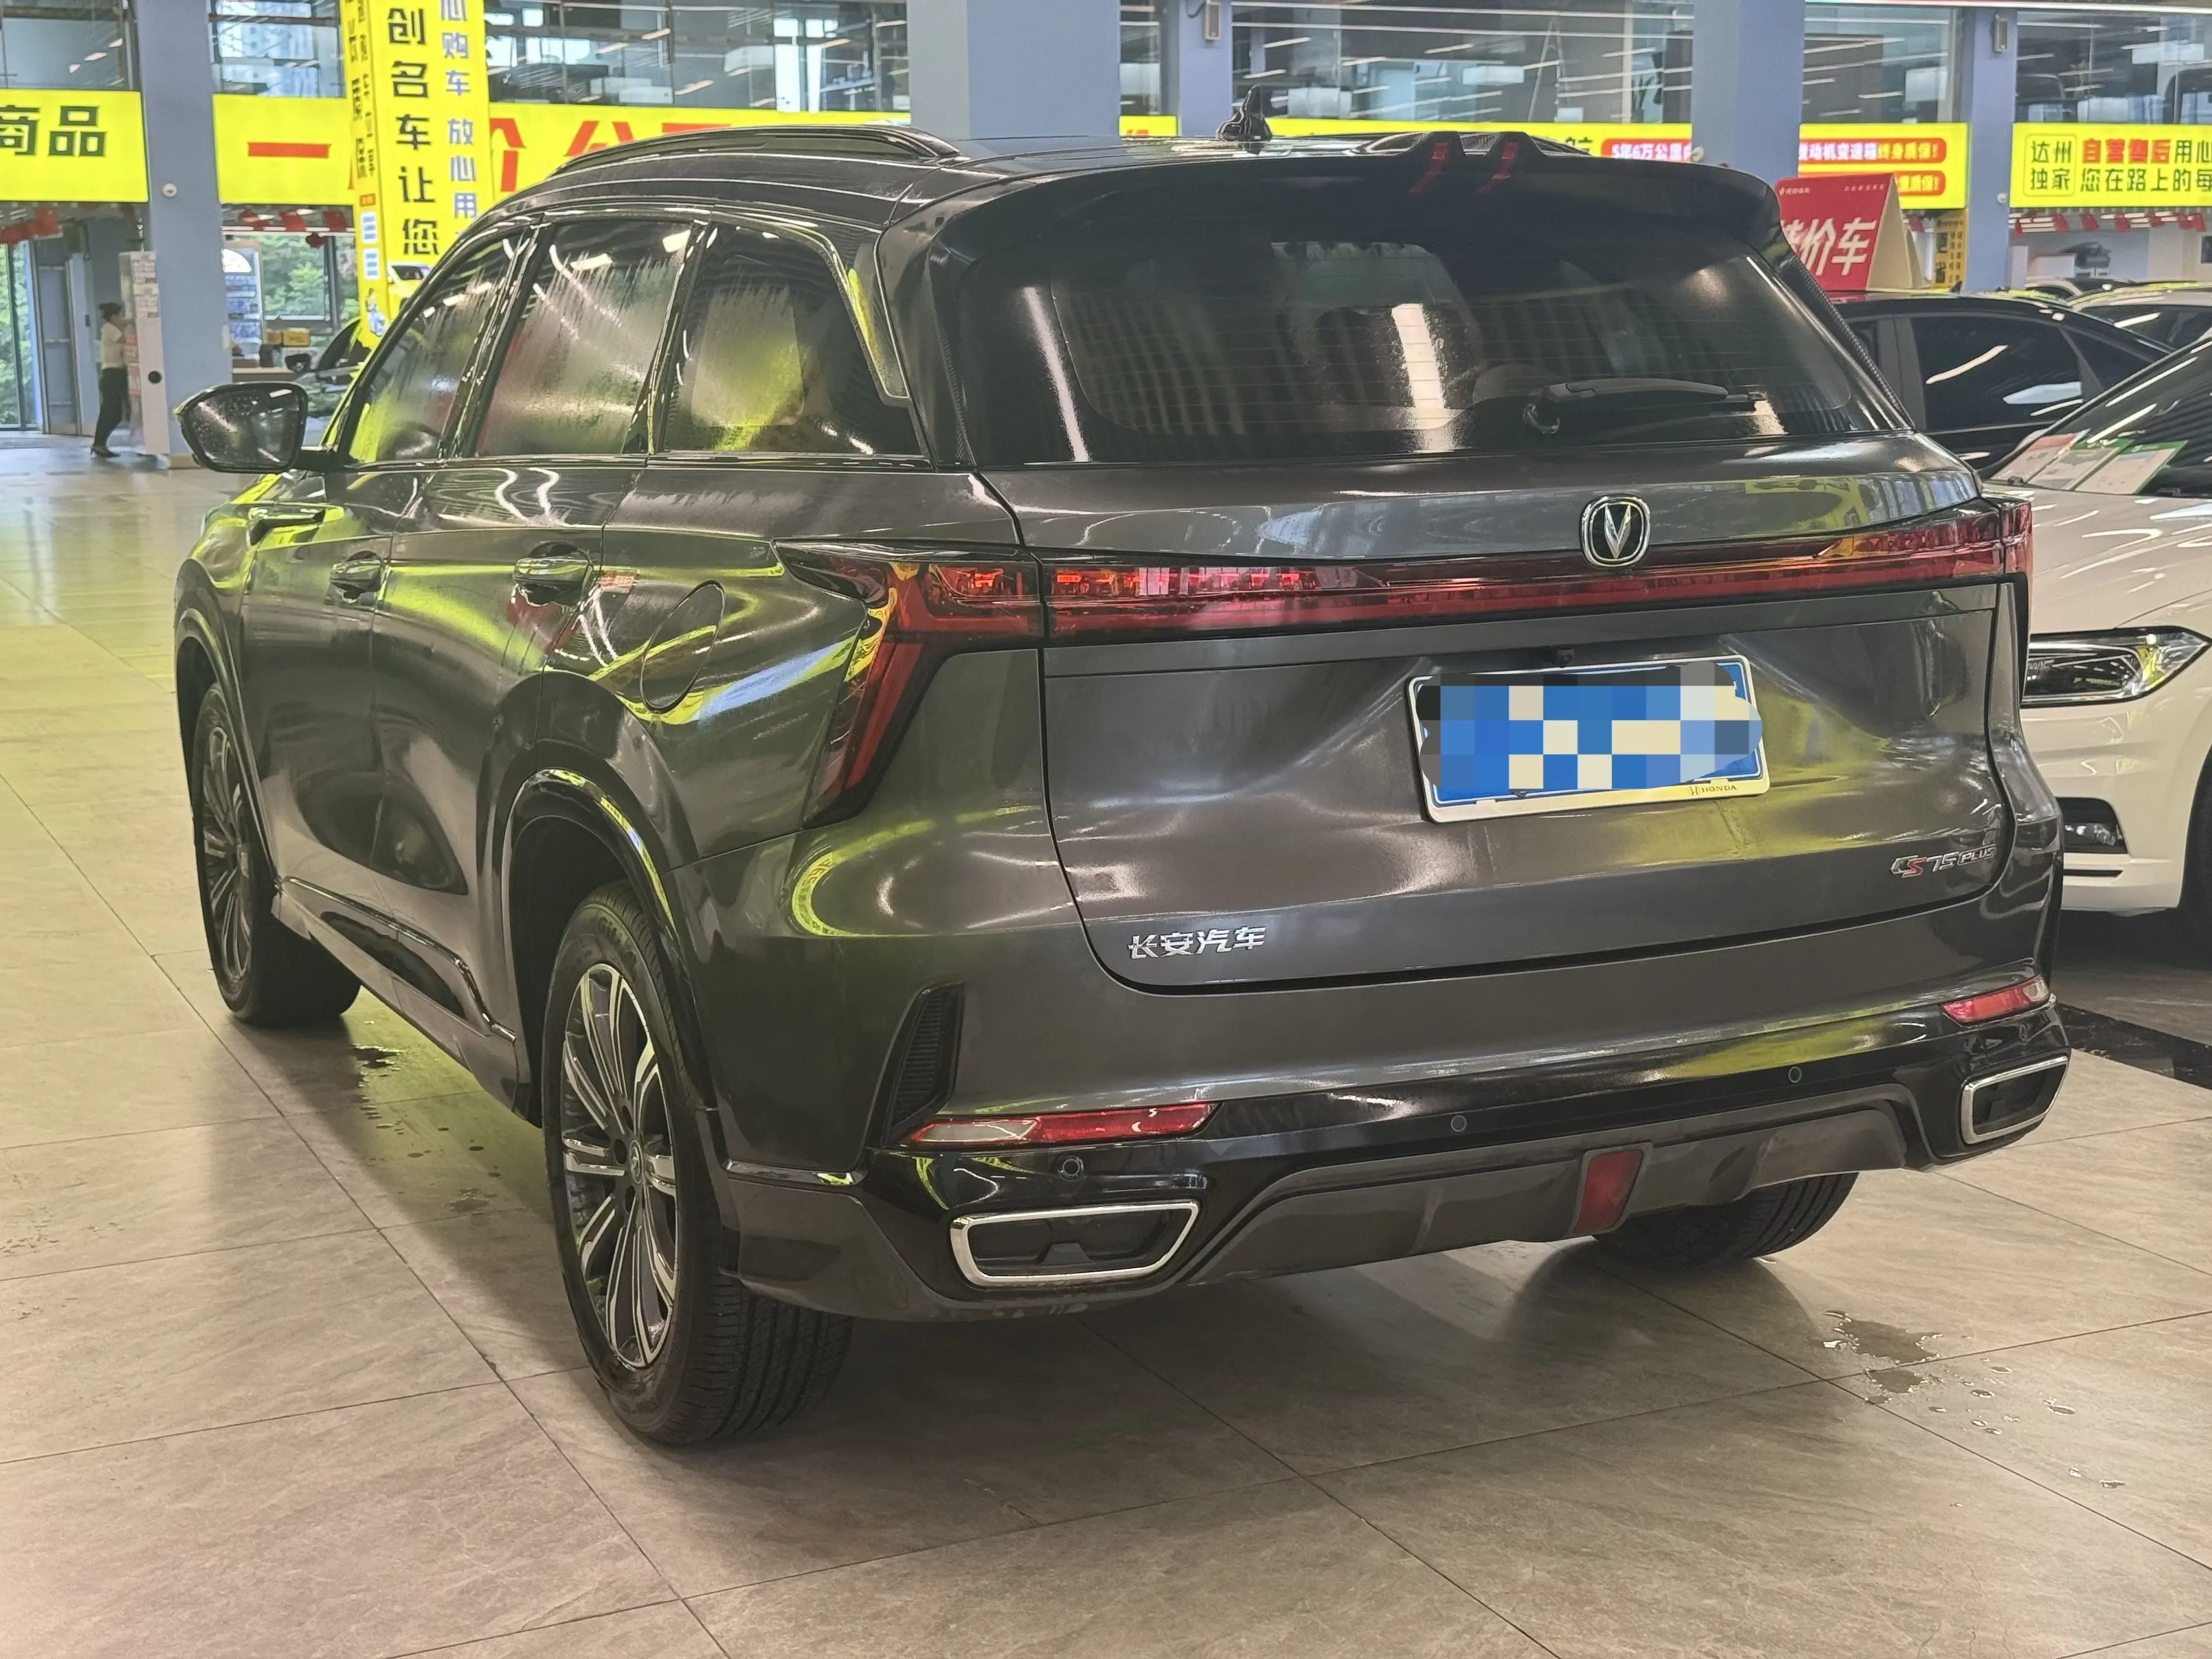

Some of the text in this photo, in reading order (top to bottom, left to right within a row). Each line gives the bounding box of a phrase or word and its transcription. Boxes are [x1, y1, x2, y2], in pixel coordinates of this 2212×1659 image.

[387, 8, 438, 255] 创名车让您
[2032, 141, 2071, 163] 达州
[448, 119, 477, 235] 放心用
[2030, 168, 2070, 190] 独家
[1128, 926, 1266, 959] 长安汽车
